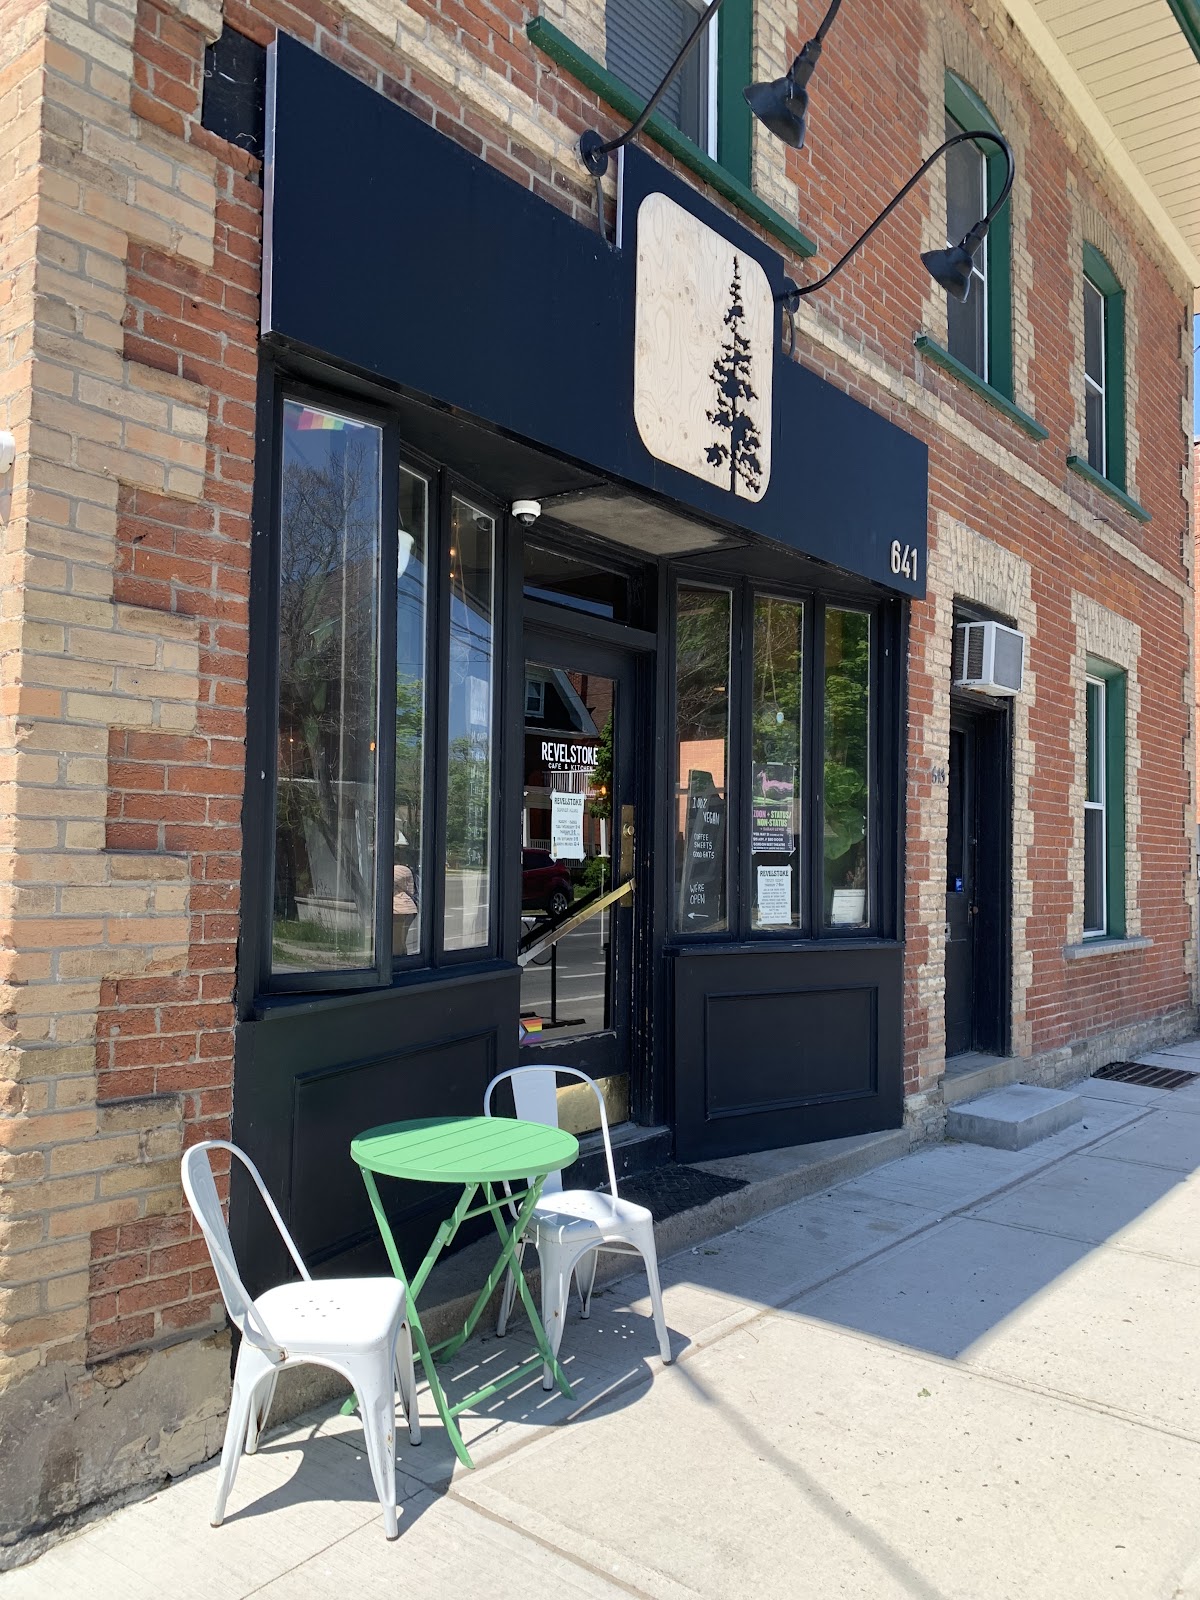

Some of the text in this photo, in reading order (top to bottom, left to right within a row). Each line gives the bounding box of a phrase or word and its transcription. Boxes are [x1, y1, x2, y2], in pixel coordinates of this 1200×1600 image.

[891, 539, 918, 582] 641
[541, 741, 599, 766] REVELSTOKE
[548, 762, 562, 770] CAFE
[554, 797, 582, 806] REVELSTOKE
[692, 797, 708, 809] 100%
[702, 811, 720, 826] VEGAN
[756, 818, 788, 827] NON-STATUS
[693, 832, 709, 841] COFFEE
[693, 841, 713, 851] SWEETS
[692, 850, 715, 860] GOOD EATS
[689, 881, 705, 894] WE'RE
[689, 893, 706, 905] OPEN
